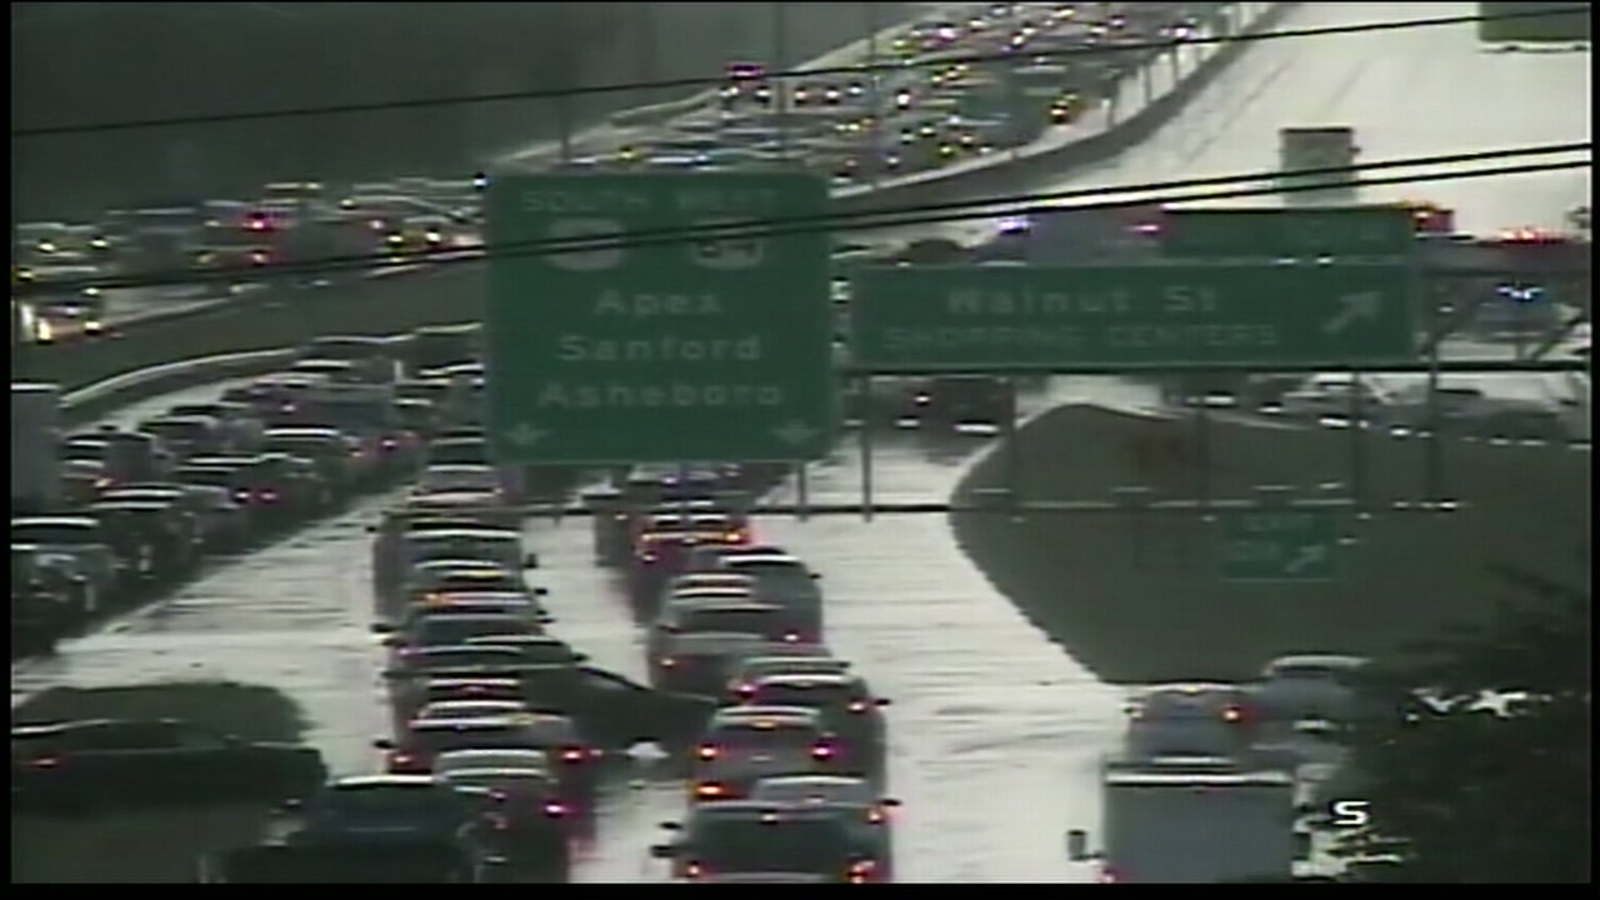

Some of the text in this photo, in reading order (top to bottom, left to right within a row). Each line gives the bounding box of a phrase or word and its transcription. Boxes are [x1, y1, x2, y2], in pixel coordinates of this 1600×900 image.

[593, 287, 724, 319] Apex
[946, 283, 1219, 315] Walnut St
[555, 333, 763, 362] Sanford
[537, 380, 786, 409] Asheboro
